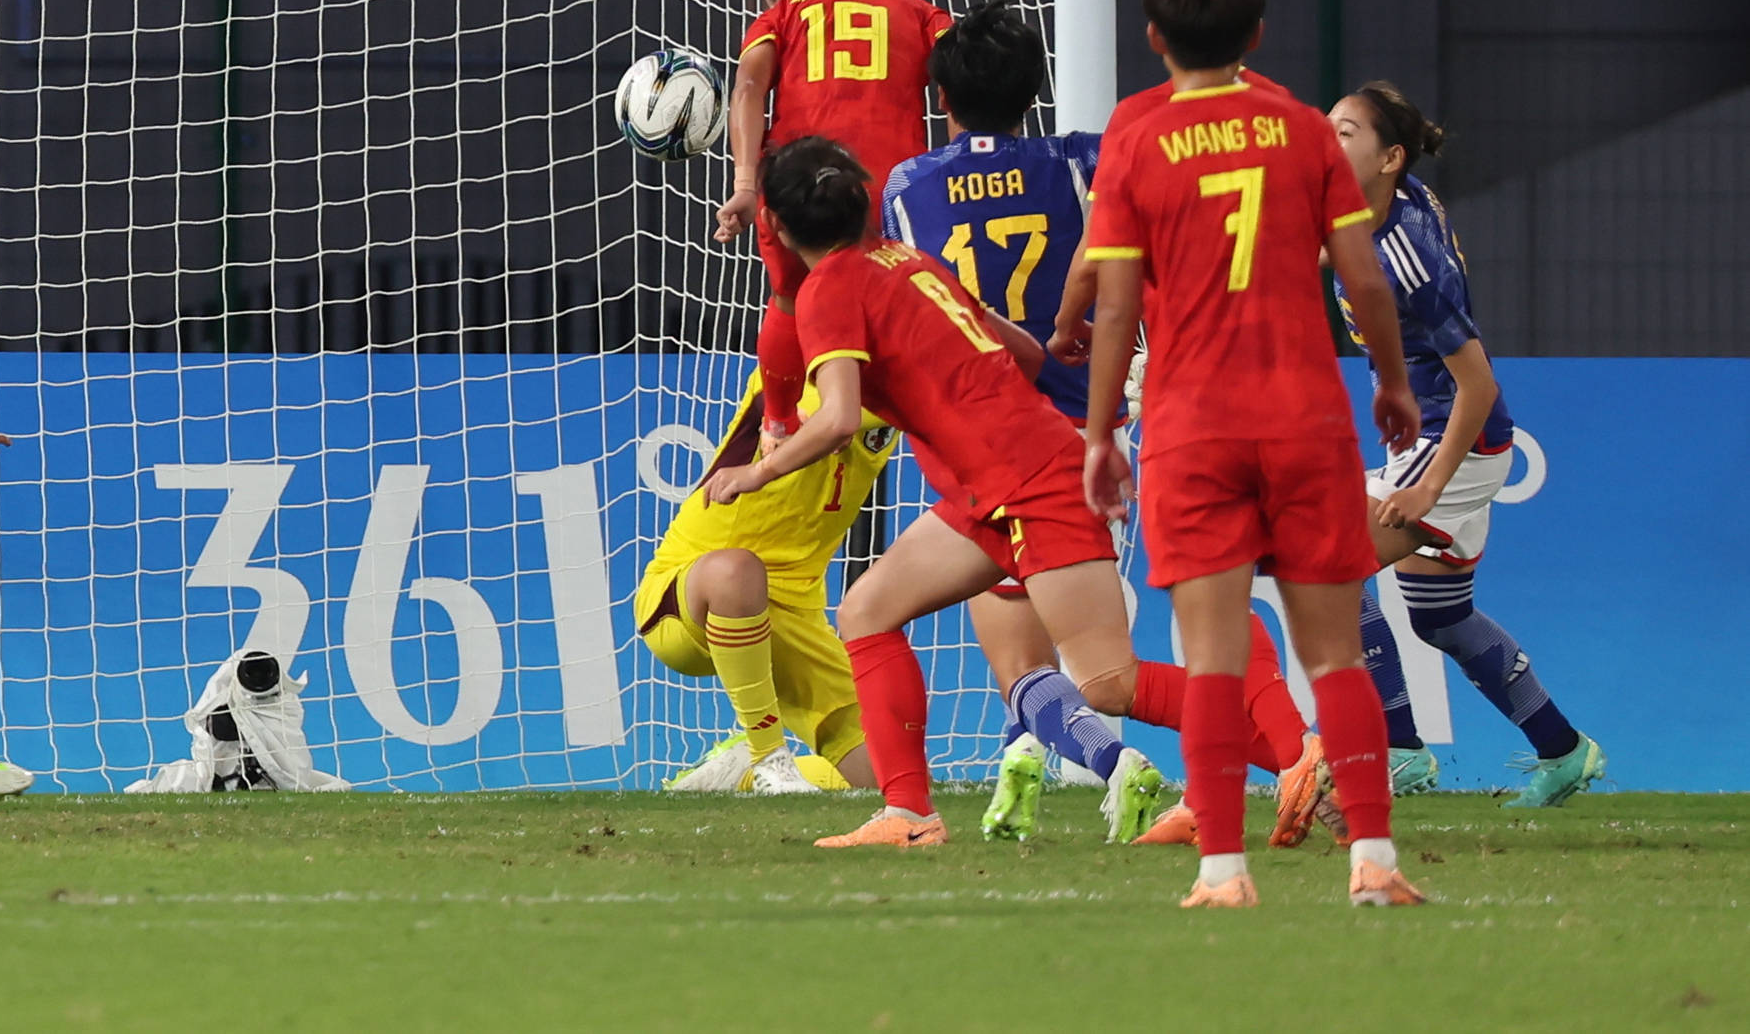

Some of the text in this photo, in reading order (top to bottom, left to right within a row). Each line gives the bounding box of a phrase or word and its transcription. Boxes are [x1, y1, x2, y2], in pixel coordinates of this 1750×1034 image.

[800, 1, 888, 82] 19
[1158, 115, 1288, 164] WANG SH
[947, 168, 1024, 204] KOGA
[1199, 166, 1266, 293] 7
[941, 213, 1048, 321] 17
[823, 462, 845, 512] 1
